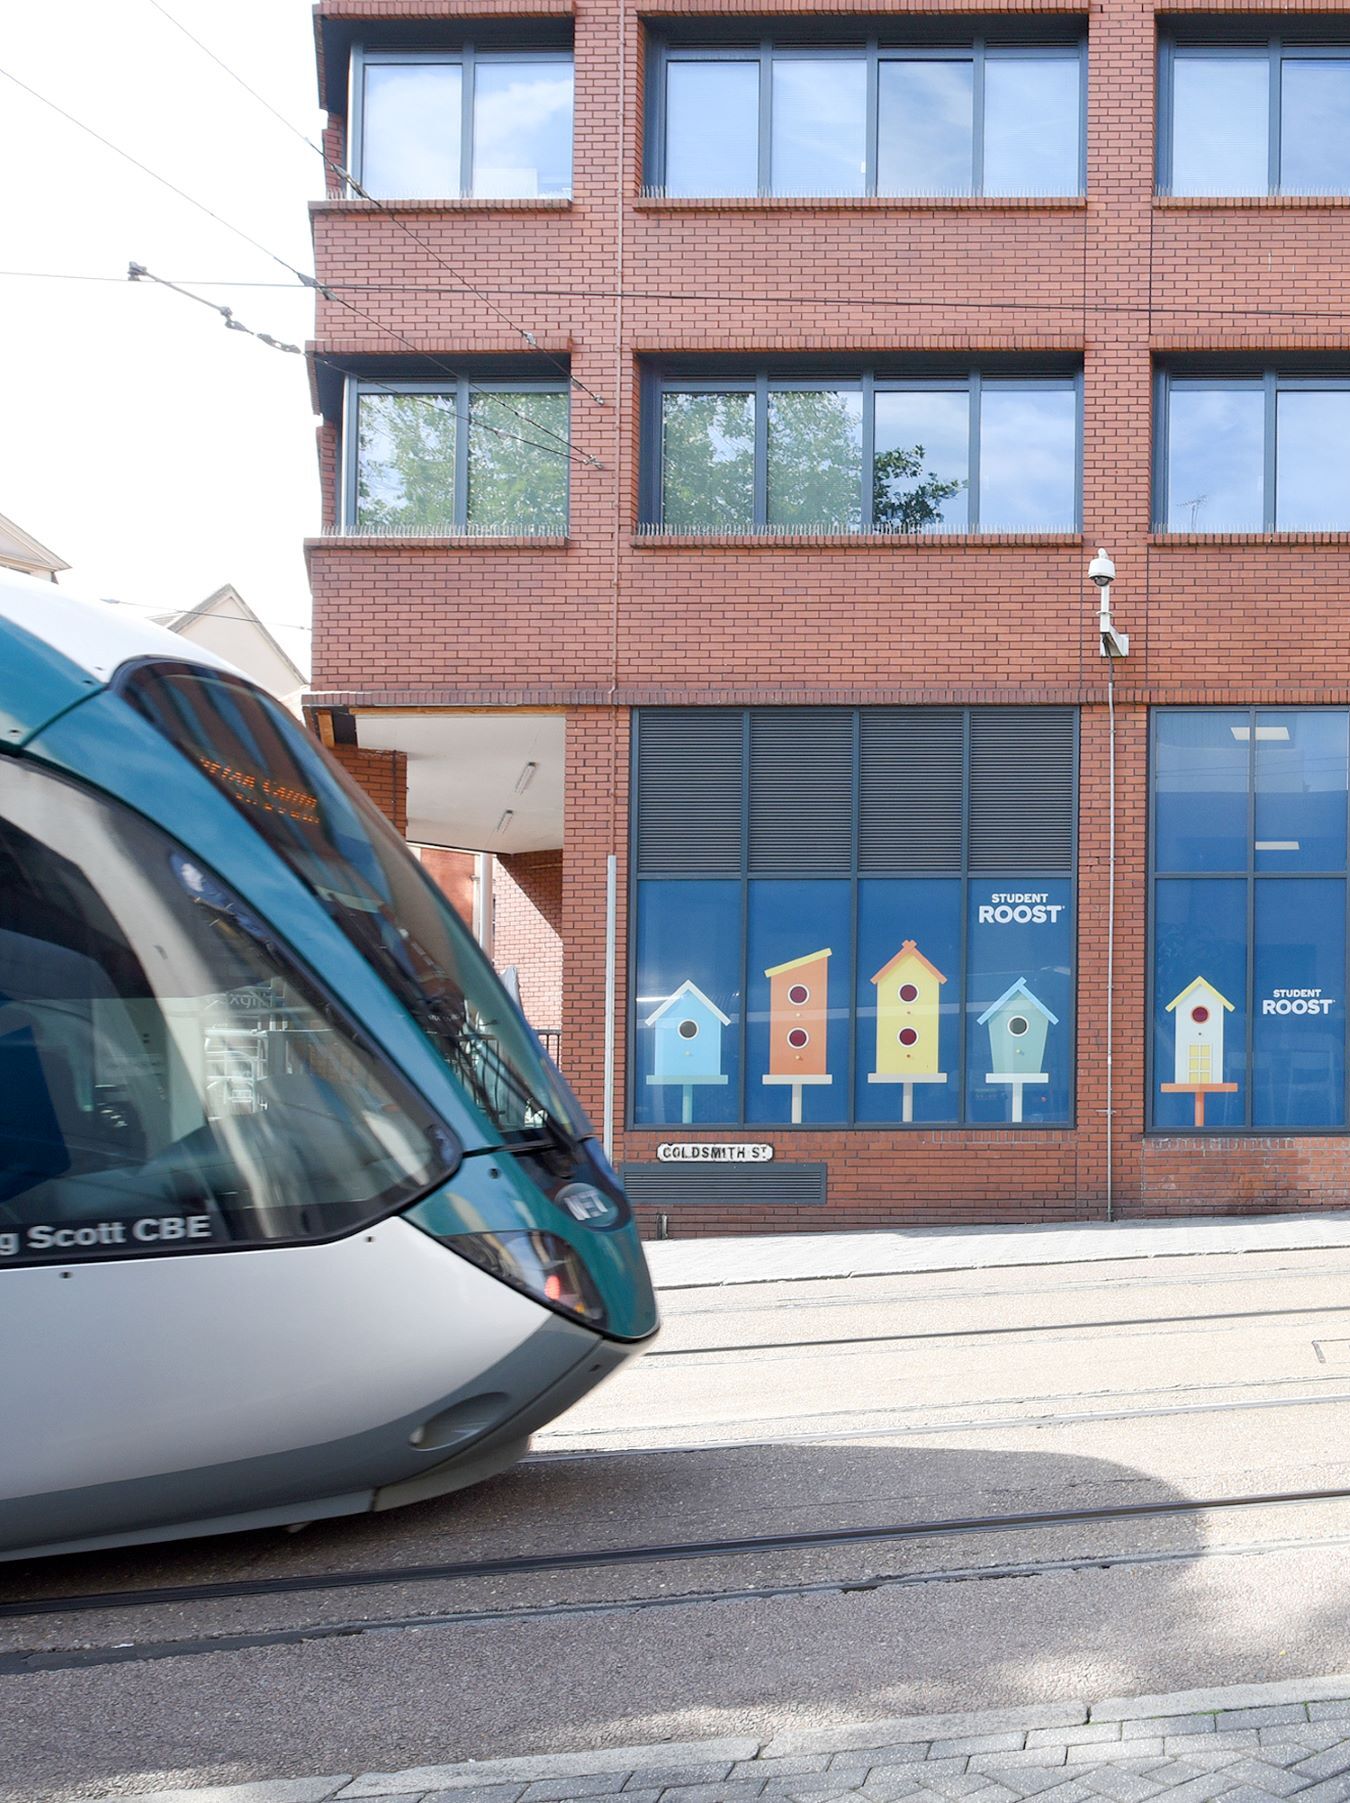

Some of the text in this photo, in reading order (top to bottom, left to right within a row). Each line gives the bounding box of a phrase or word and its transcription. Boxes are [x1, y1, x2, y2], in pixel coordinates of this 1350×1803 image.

[991, 893, 1049, 904] STUDENT
[979, 905, 1062, 924] ROOST
[1273, 989, 1322, 998] STUDENT
[1262, 999, 1334, 1015] ROOST
[27, 1222, 127, 1249] Scott
[133, 1215, 212, 1242] CBE
